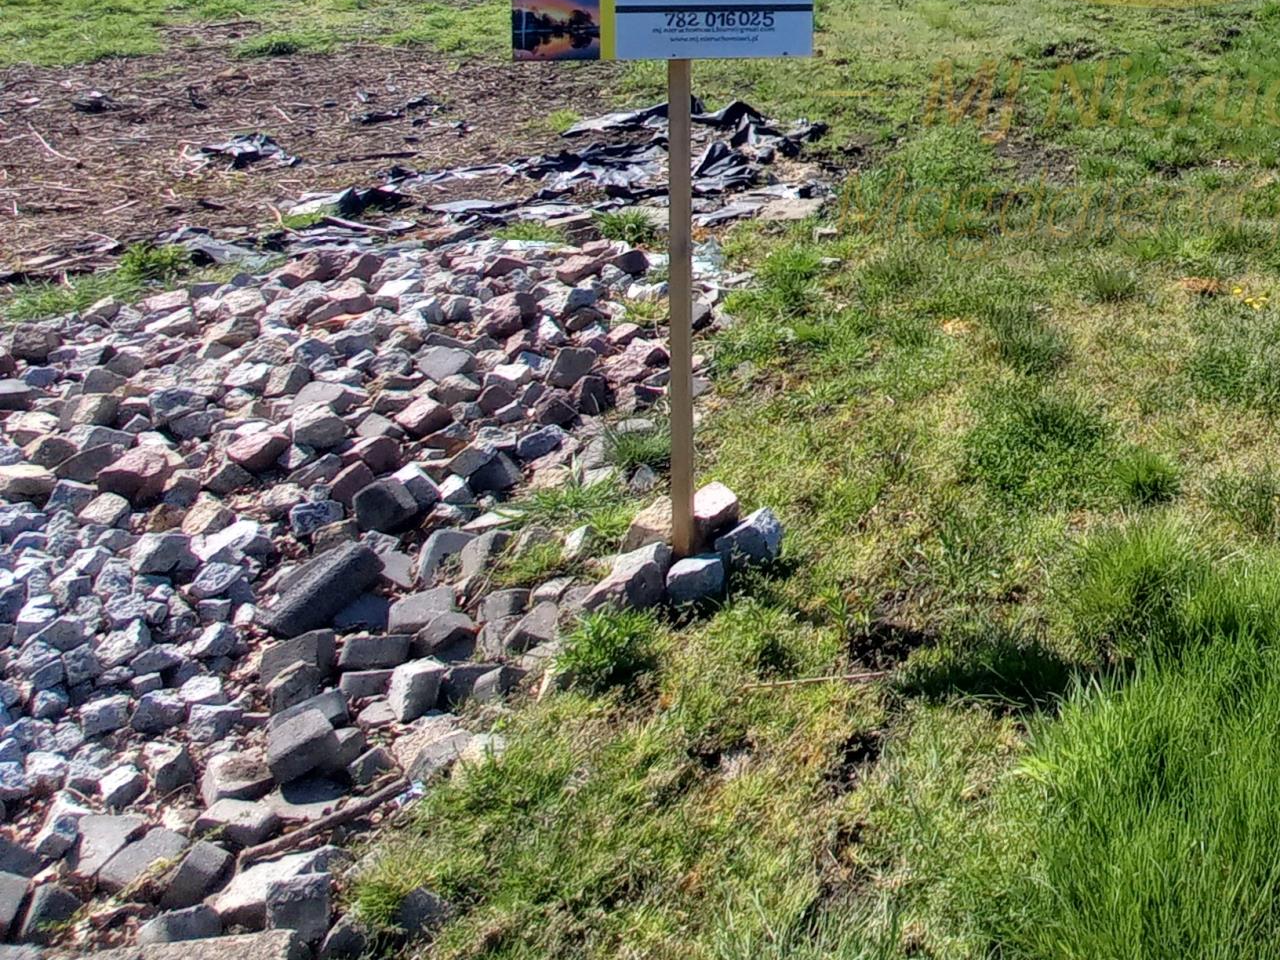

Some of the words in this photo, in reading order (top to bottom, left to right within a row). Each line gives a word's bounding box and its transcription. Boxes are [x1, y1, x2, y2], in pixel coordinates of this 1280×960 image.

[664, 12, 700, 28] 782
[705, 11, 736, 28] 016
[739, 11, 775, 28] 025
